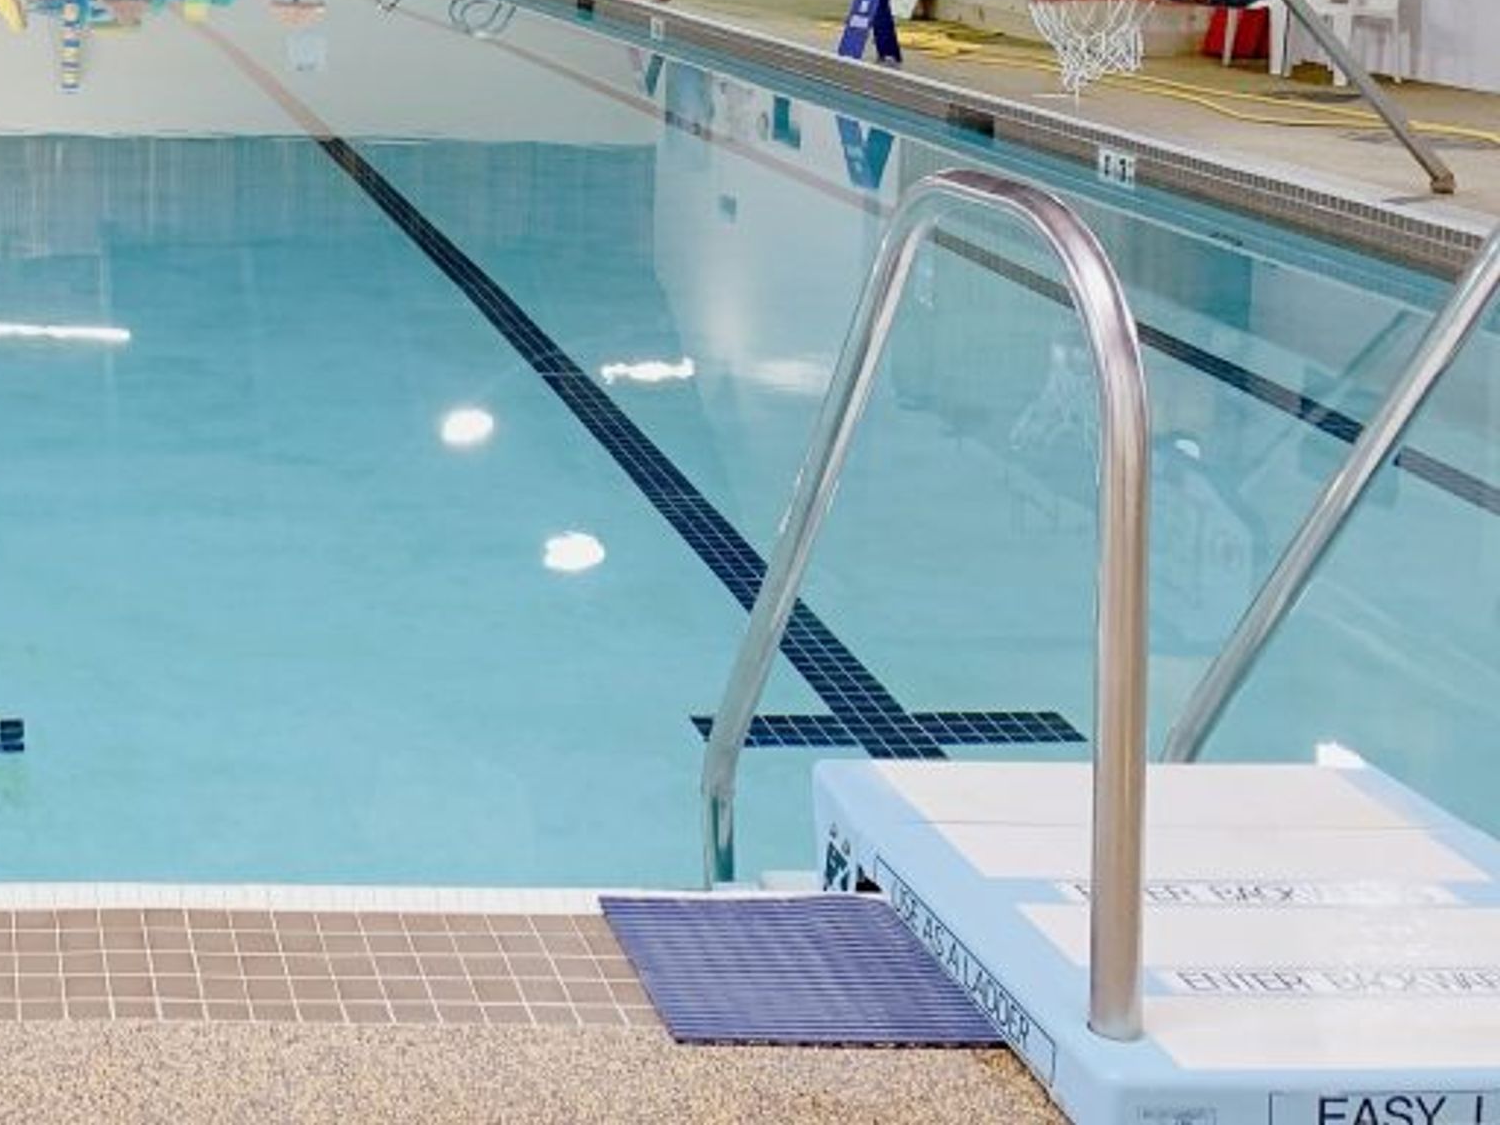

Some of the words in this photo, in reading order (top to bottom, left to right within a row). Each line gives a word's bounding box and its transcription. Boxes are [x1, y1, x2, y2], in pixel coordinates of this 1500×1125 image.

[891, 878, 919, 932] USE
[922, 916, 944, 956] AS
[946, 942, 960, 976] A
[962, 954, 1031, 1050] LADDER
[1177, 971, 1312, 992] ENTER
[1318, 1095, 1447, 1125] EASY
